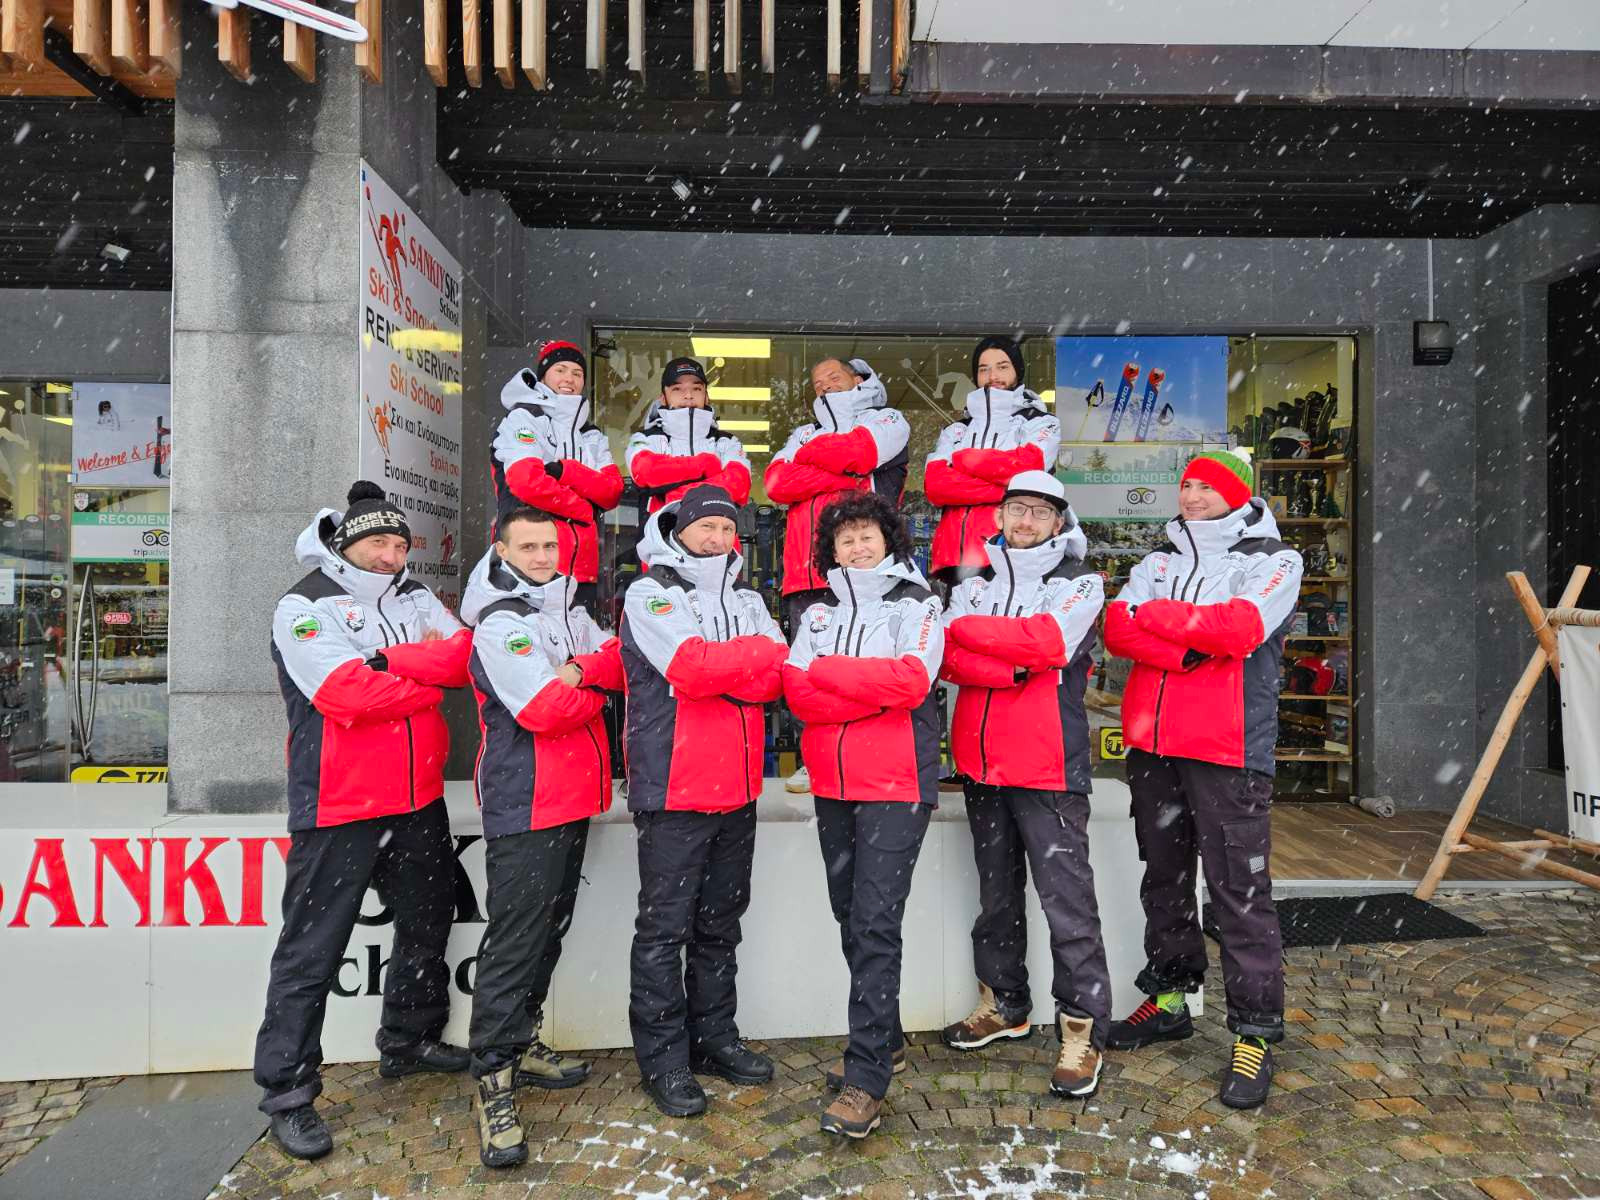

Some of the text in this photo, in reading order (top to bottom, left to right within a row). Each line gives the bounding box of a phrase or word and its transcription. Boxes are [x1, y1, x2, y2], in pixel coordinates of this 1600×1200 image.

[369, 266, 389, 306] Ski
[393, 287, 402, 315] &
[390, 363, 444, 416] Ski School
[77, 450, 127, 471] Welcome
[131, 444, 141, 460] &
[1084, 472, 1177, 484] RECOMENDED
[346, 518, 400, 538] REBELS
